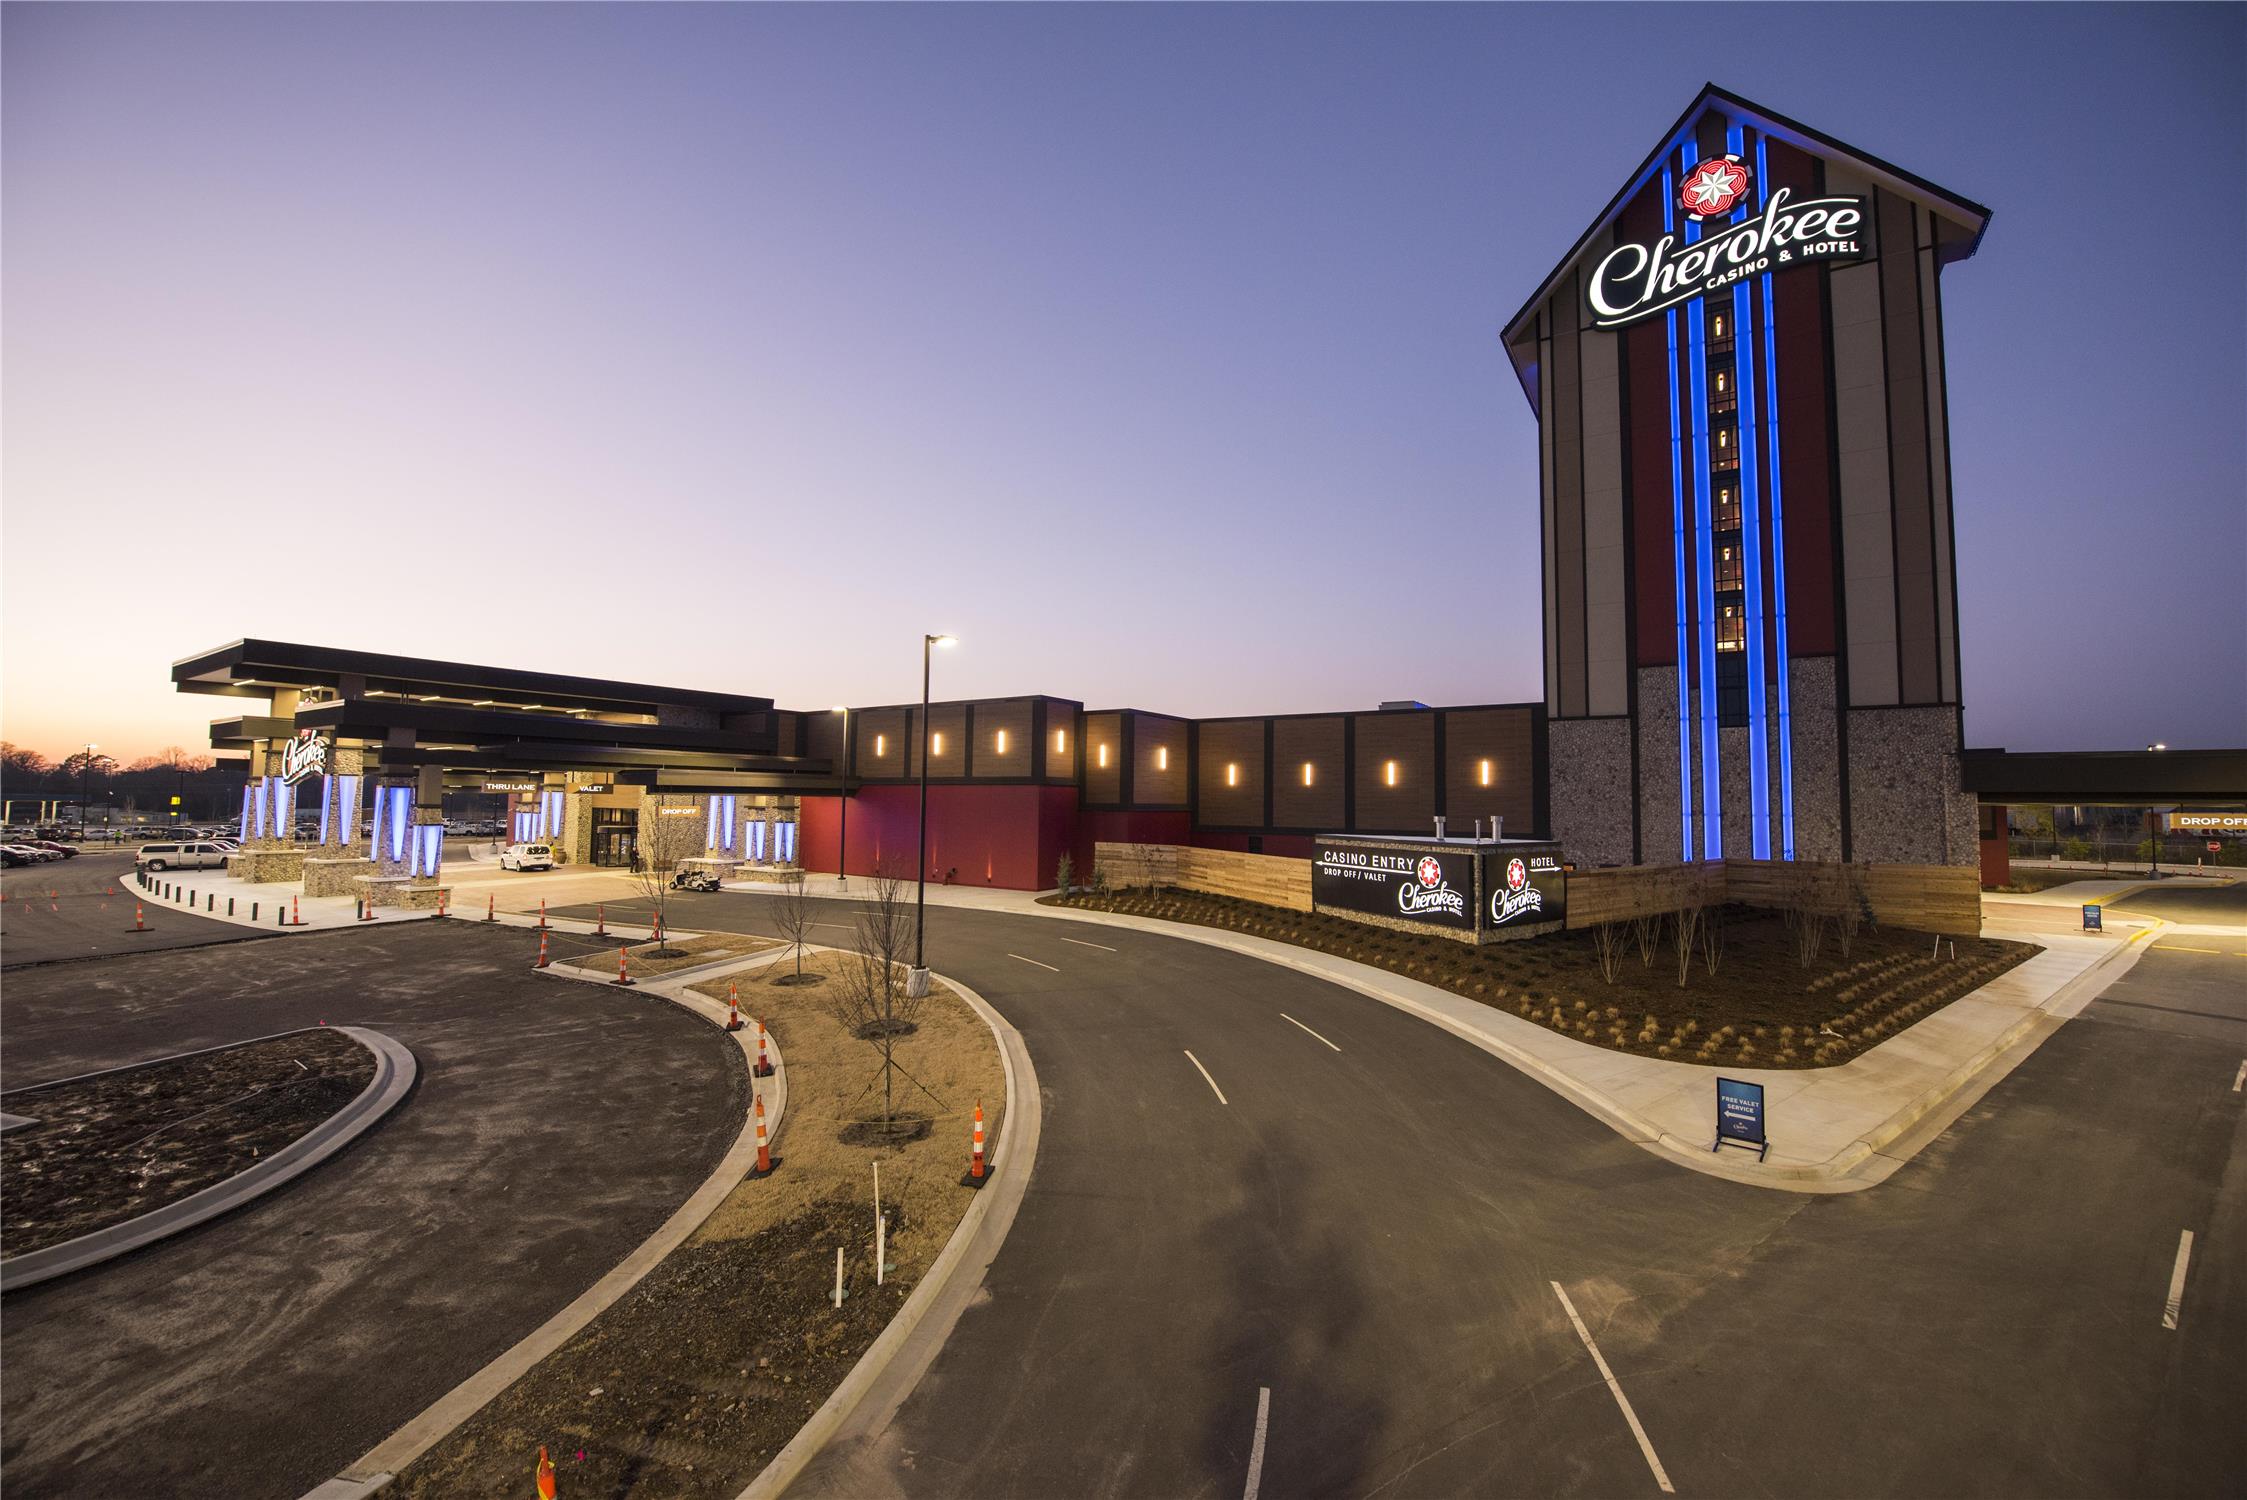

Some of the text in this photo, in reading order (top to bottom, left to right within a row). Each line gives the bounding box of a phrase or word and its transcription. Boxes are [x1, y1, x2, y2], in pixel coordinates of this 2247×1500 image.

[1589, 187, 1861, 316] Cherokee
[1706, 241, 1860, 290] CASINO & HOTEL
[282, 729, 326, 780] Cherokee
[2181, 817, 2221, 825] DROP
[1324, 850, 1414, 871] CASINO ENTRY
[1531, 857, 1554, 867] HOTEL
[1324, 867, 1341, 877] DROP
[1363, 872, 1387, 882] VALET
[1398, 881, 1464, 911] Cherokee
[1491, 880, 1542, 920] Cherokee
[1721, 1096, 1760, 1107] FREE VALET
[1727, 1103, 1754, 1113] SERVICE
